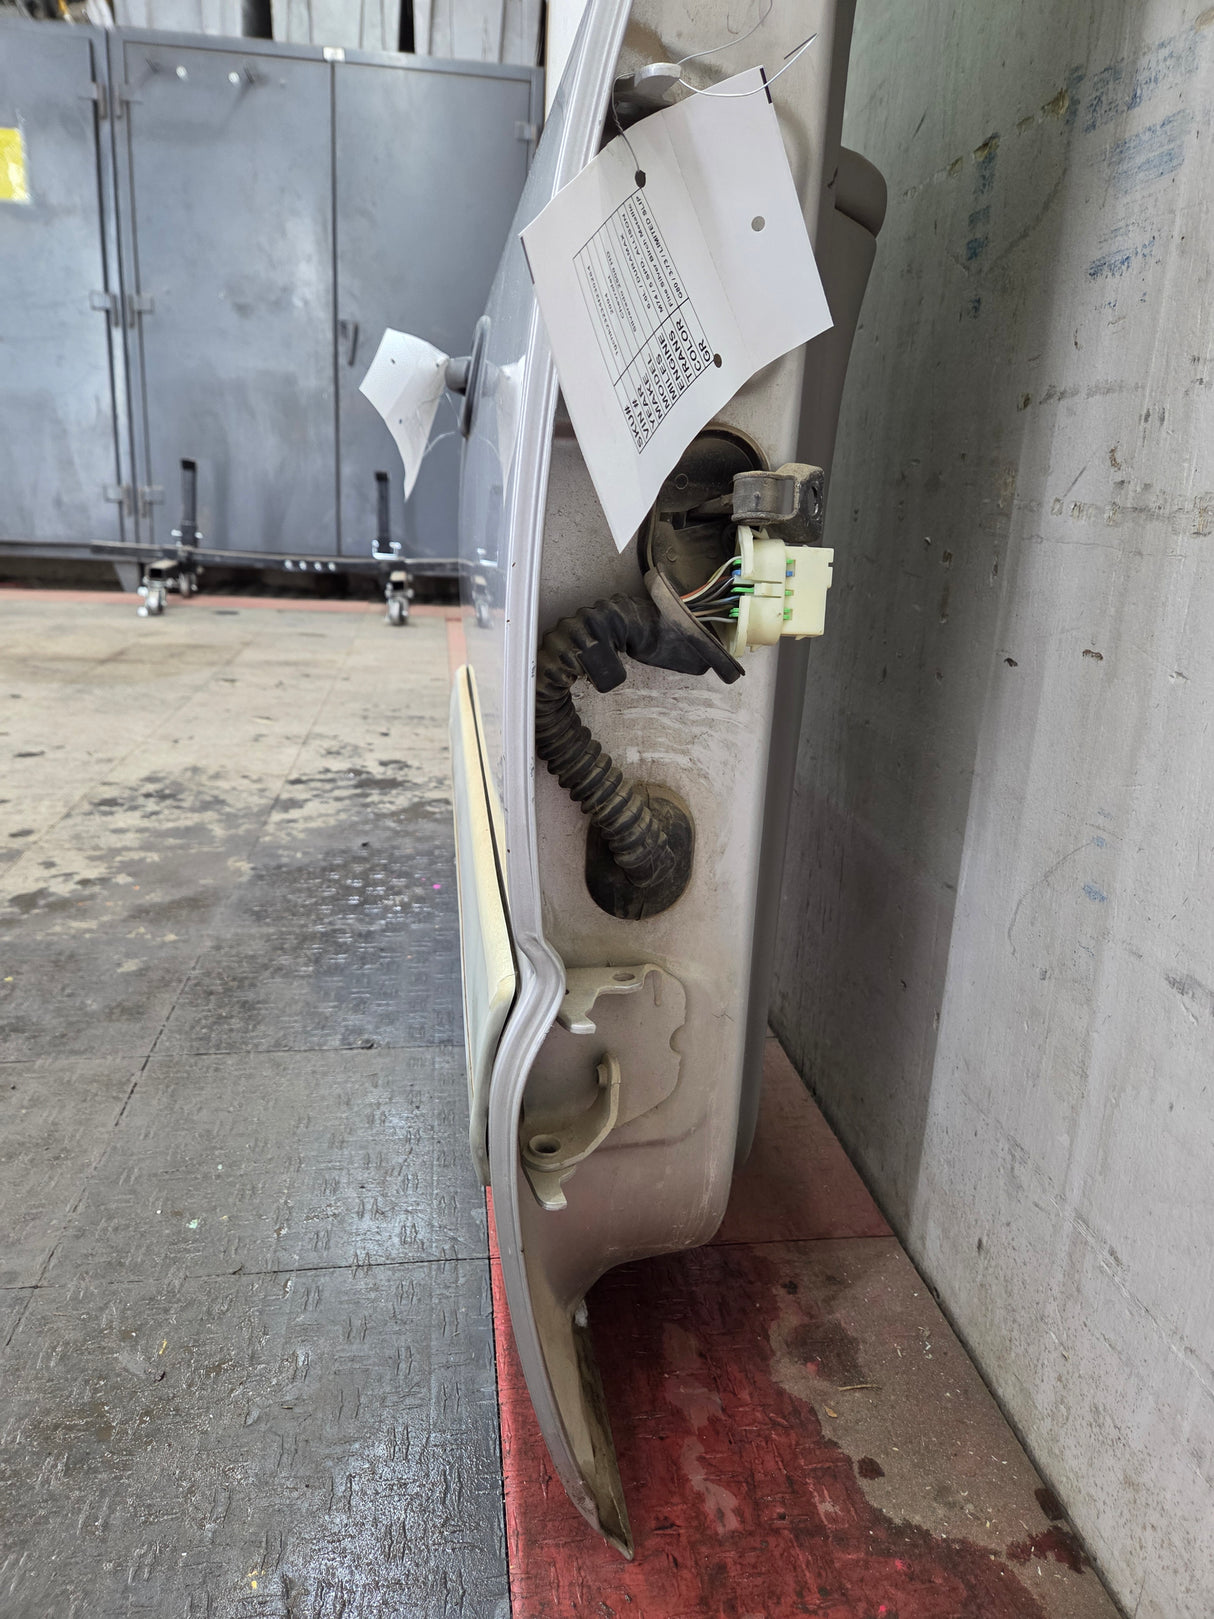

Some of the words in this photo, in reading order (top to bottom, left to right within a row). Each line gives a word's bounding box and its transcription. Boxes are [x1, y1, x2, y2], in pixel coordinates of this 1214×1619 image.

[627, 202, 643, 238] Metallic
[635, 194, 647, 217] SLIP
[621, 212, 640, 256] ALLISON
[641, 237, 653, 262] Birch
[645, 216, 663, 254] LIMITED
[606, 250, 613, 266] HD
[619, 233, 640, 283] DURAMAX
[652, 262, 664, 288] Silver
[663, 258, 673, 277] 3.73
[604, 292, 613, 315] 2004
[607, 274, 624, 319] Chevrolet
[654, 293, 663, 313] M74
[662, 287, 672, 308] Fine
[673, 281, 682, 299] G80
[619, 289, 637, 332] Silverado
[657, 331, 685, 392] ENGINE
[667, 328, 693, 382] TRANS
[675, 317, 702, 373] COLOR
[697, 338, 711, 363] GR
[644, 352, 670, 410] MODEL
[655, 352, 677, 400] MILES
[636, 383, 656, 429] YEAR
[641, 372, 663, 420] MAKE
[636, 410, 650, 439] VIN
